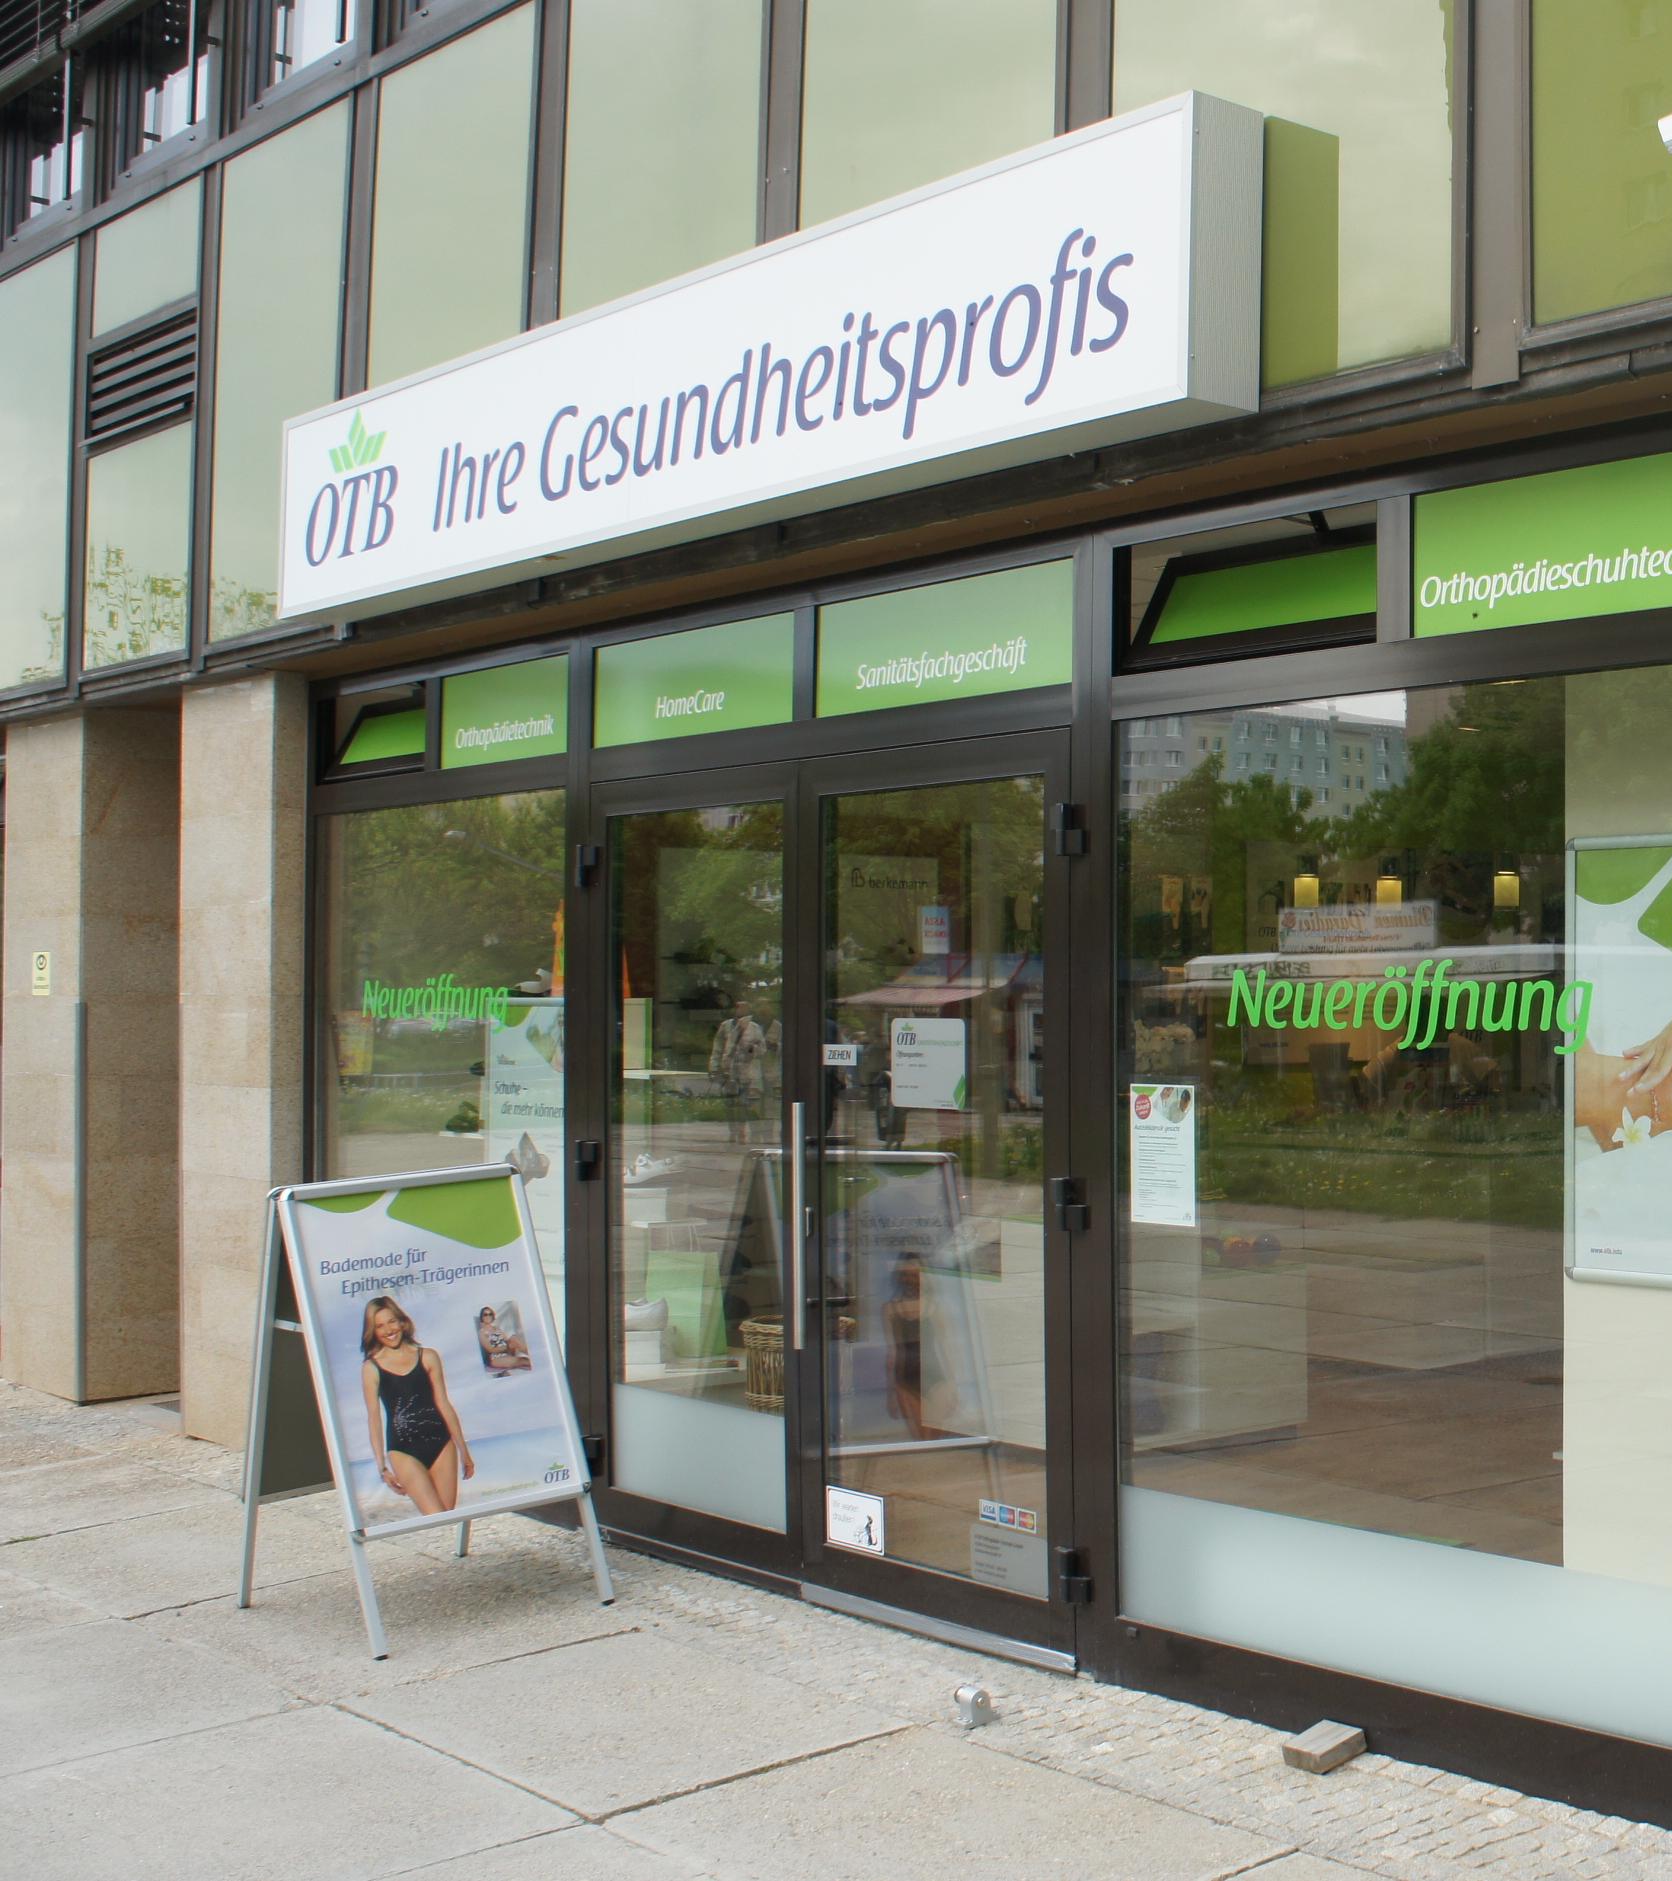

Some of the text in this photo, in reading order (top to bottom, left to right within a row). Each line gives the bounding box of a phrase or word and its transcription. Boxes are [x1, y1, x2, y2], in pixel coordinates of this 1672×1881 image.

[305, 226, 1135, 567] OTB Ihre Gesundheitsprofis
[856, 635, 1028, 691] Sanitätsfachgeschäft
[655, 690, 725, 719] HomeCare
[454, 713, 554, 750] Orthopädietechnik
[362, 974, 509, 1033] Neueröffnung
[1226, 959, 1594, 1055] Neueröffnung
[896, 1032, 916, 1046] OTB
[320, 1248, 428, 1275] Bademode für
[341, 1261, 510, 1297] Epithesen-Trägerinnen
[544, 1468, 570, 1483] OTB
[983, 1503, 995, 1514] VISA
